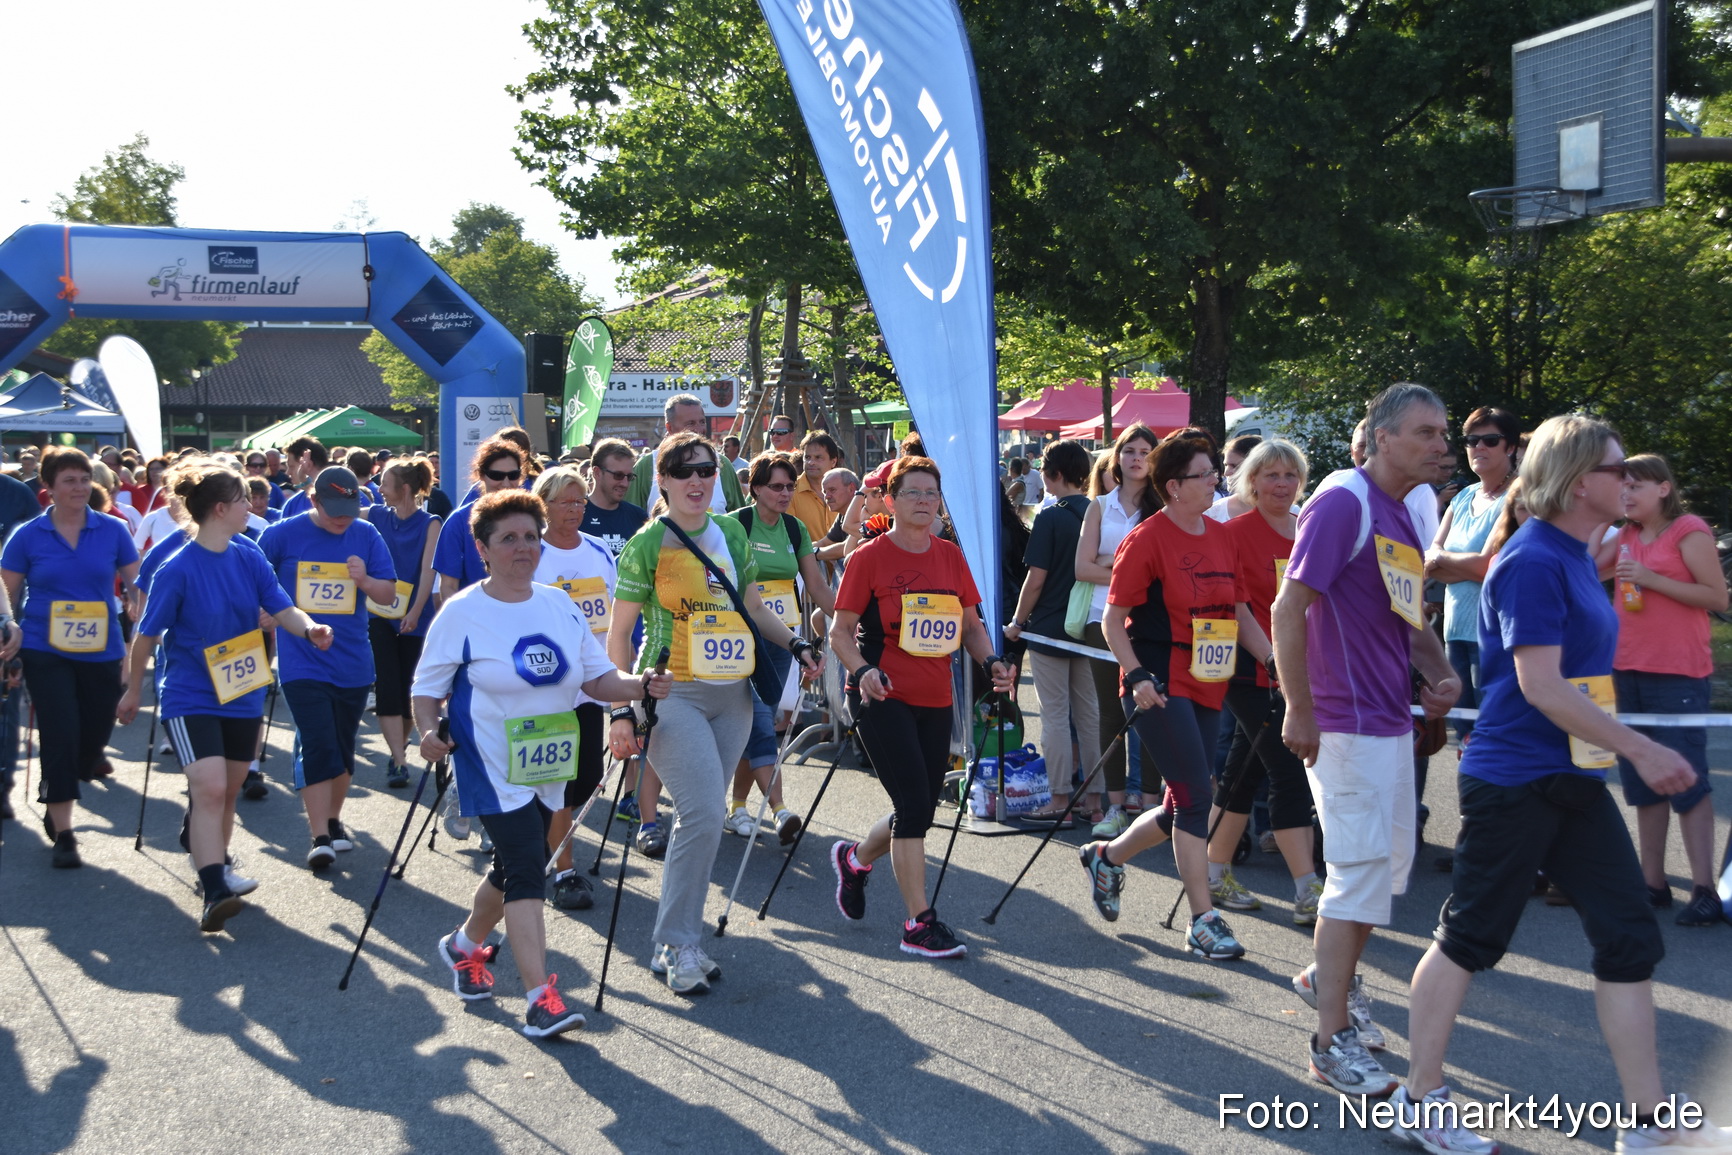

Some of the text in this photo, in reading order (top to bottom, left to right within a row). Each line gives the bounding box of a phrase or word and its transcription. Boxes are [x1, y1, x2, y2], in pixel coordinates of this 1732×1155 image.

[219, 256, 256, 265] Fischer
[191, 274, 301, 295] firmenlauf
[191, 294, 237, 302] neumarkt
[0, 310, 36, 322] cher
[412, 314, 428, 323] und
[428, 312, 444, 321] das
[583, 365, 607, 398] AOK
[608, 381, 627, 391] ra
[564, 389, 586, 428] AOK
[309, 583, 345, 600] 752
[1386, 571, 1412, 604] 310
[573, 598, 606, 619] 98
[63, 622, 98, 638] 754
[908, 618, 957, 640] 1099
[525, 650, 552, 665] TÜV
[703, 638, 746, 661] 992
[1196, 644, 1234, 665] 1097
[221, 656, 256, 684] 759
[536, 666, 552, 675] SÜD
[517, 740, 573, 769] 1483
